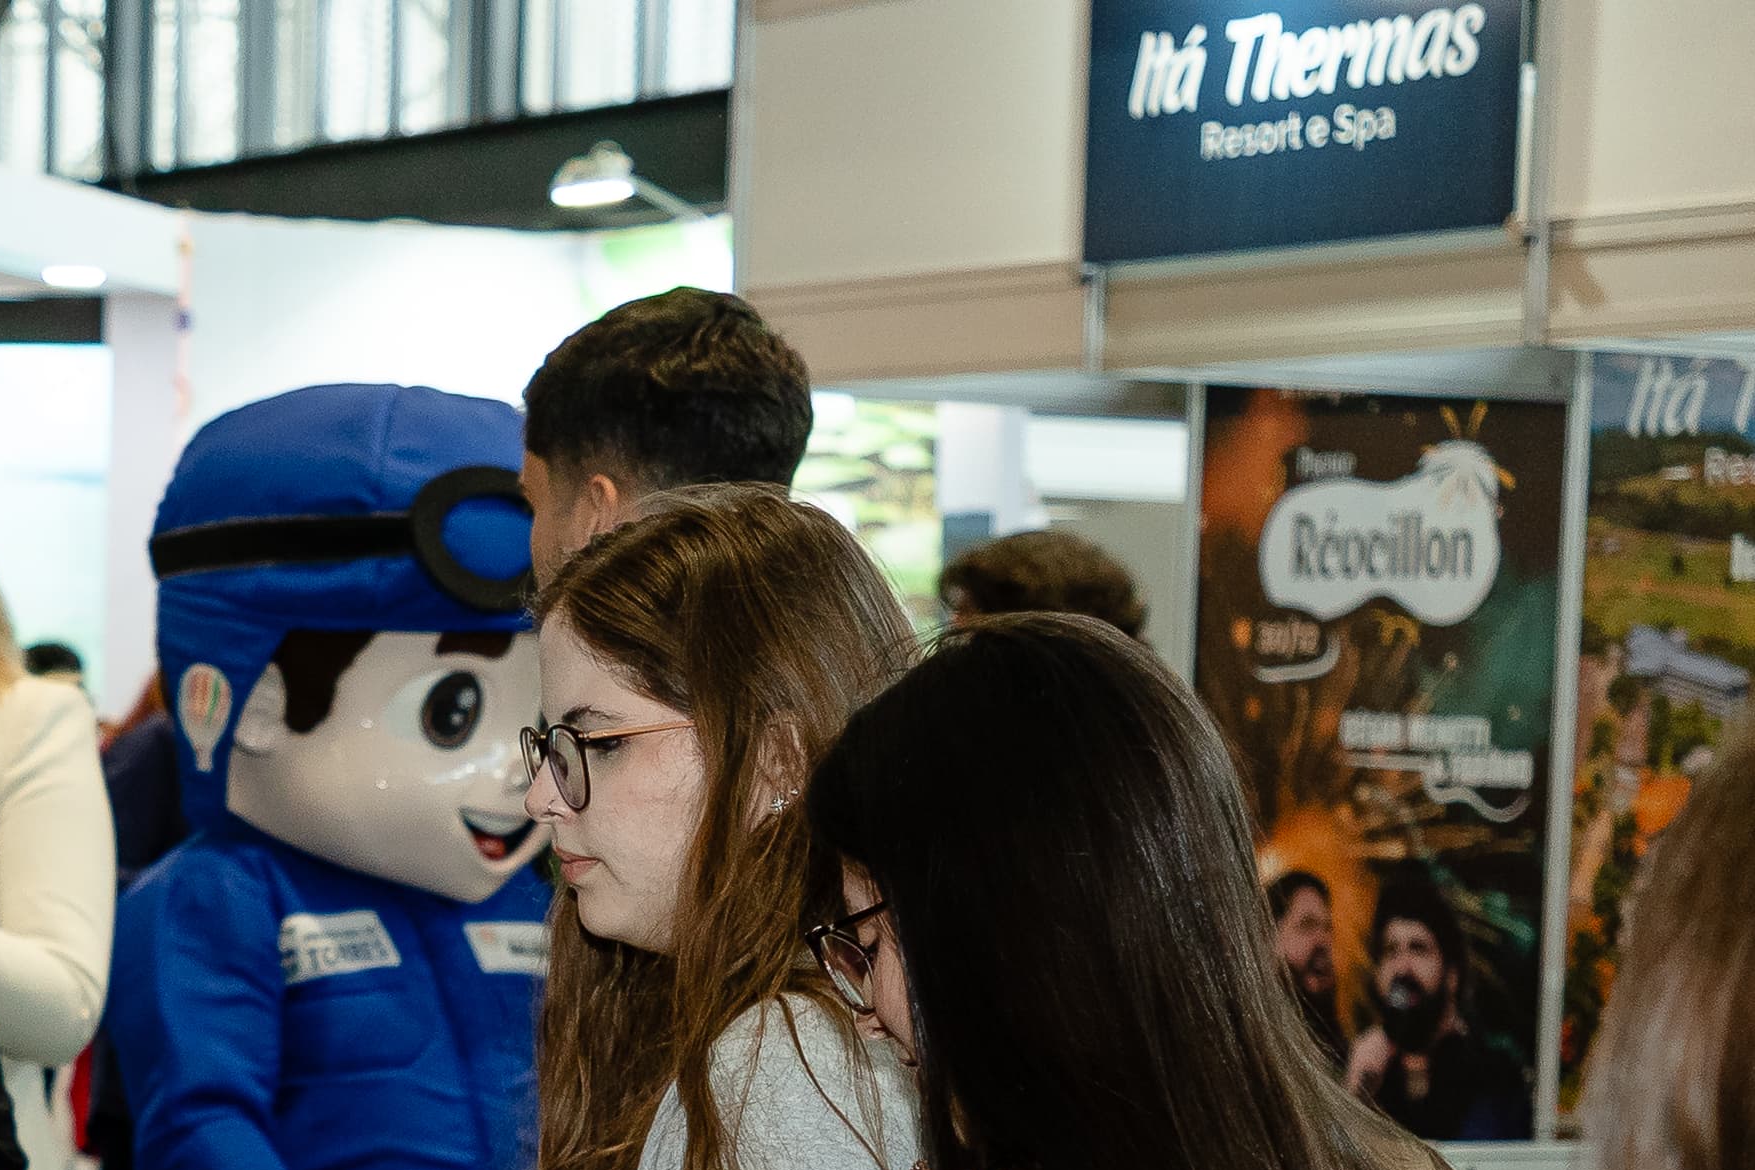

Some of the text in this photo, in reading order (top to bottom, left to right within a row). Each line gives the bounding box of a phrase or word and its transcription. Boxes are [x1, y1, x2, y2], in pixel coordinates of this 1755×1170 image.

[1127, 3, 1486, 120] Itá Thermas
[1200, 103, 1397, 161] Resort e Spa
